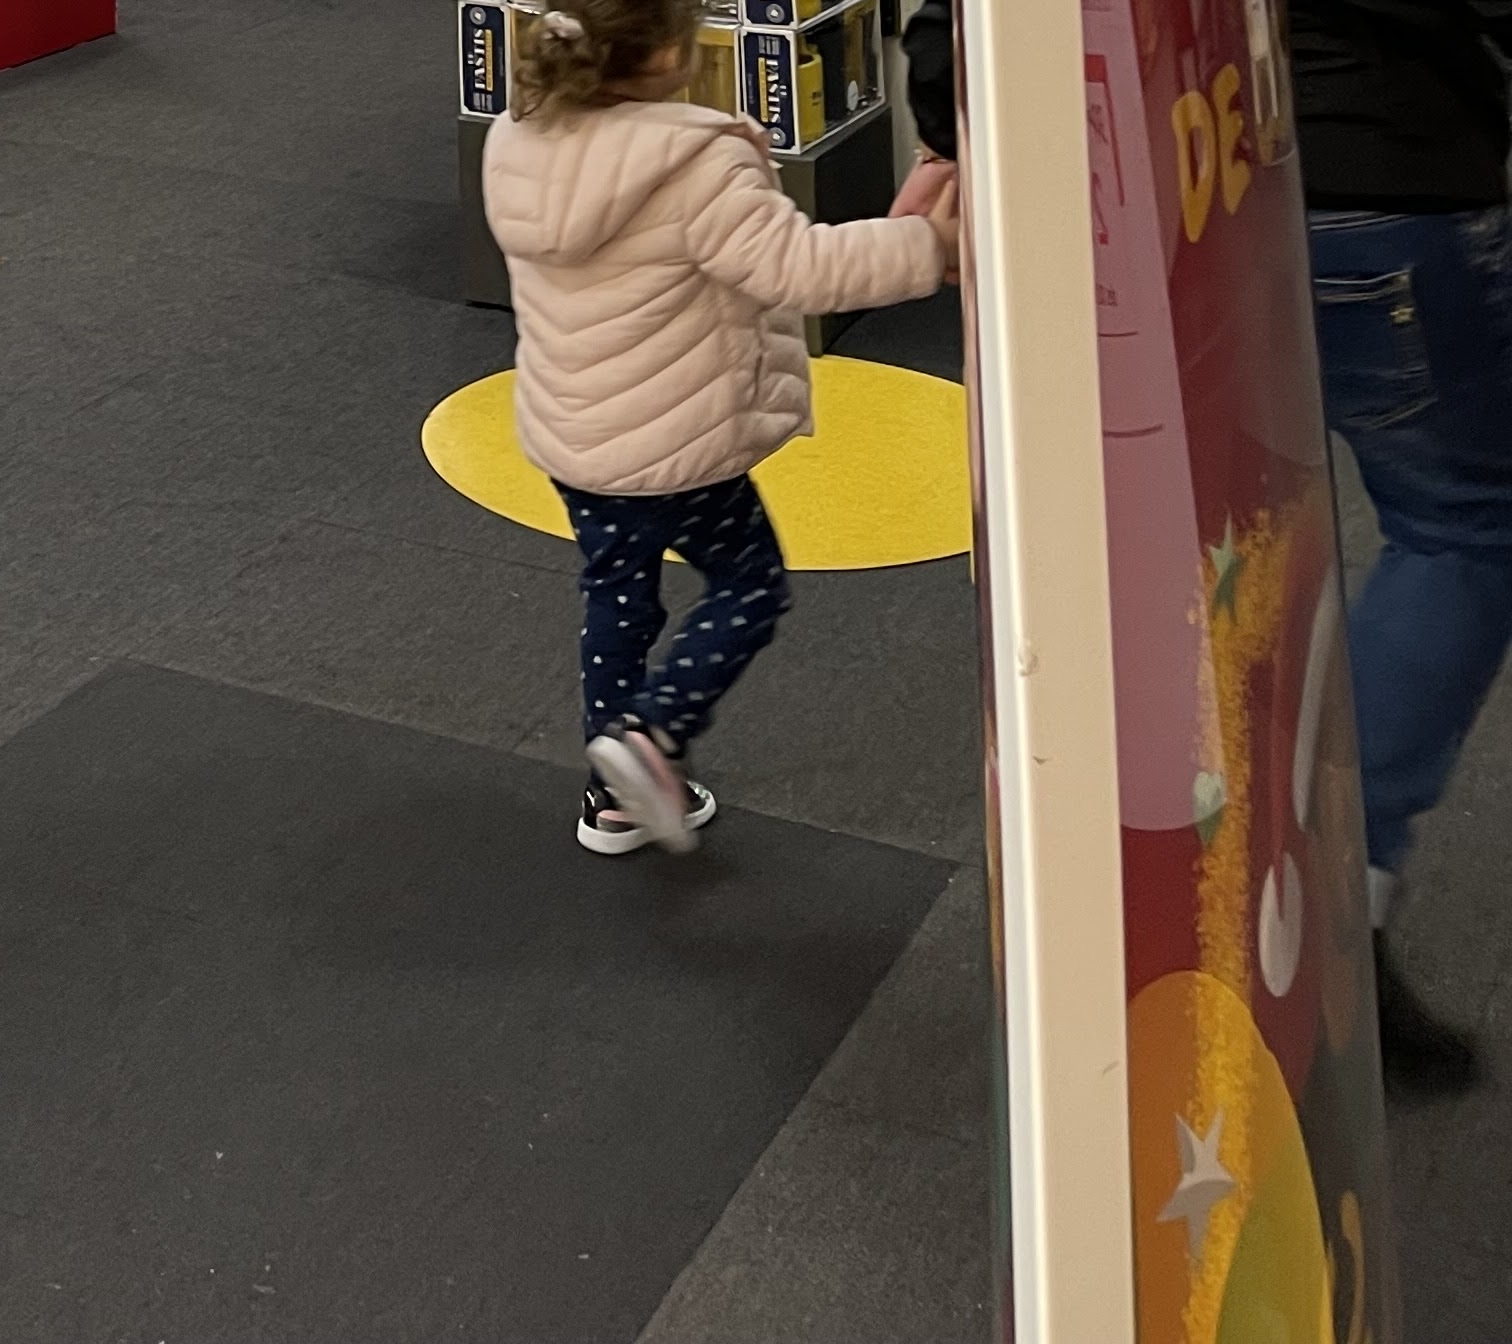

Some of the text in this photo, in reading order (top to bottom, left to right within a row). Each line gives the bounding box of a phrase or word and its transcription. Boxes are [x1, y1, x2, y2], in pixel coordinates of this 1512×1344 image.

[473, 27, 485, 89] PASTIS
[766, 59, 781, 124] PASTIS
[1172, 63, 1252, 243] DE
